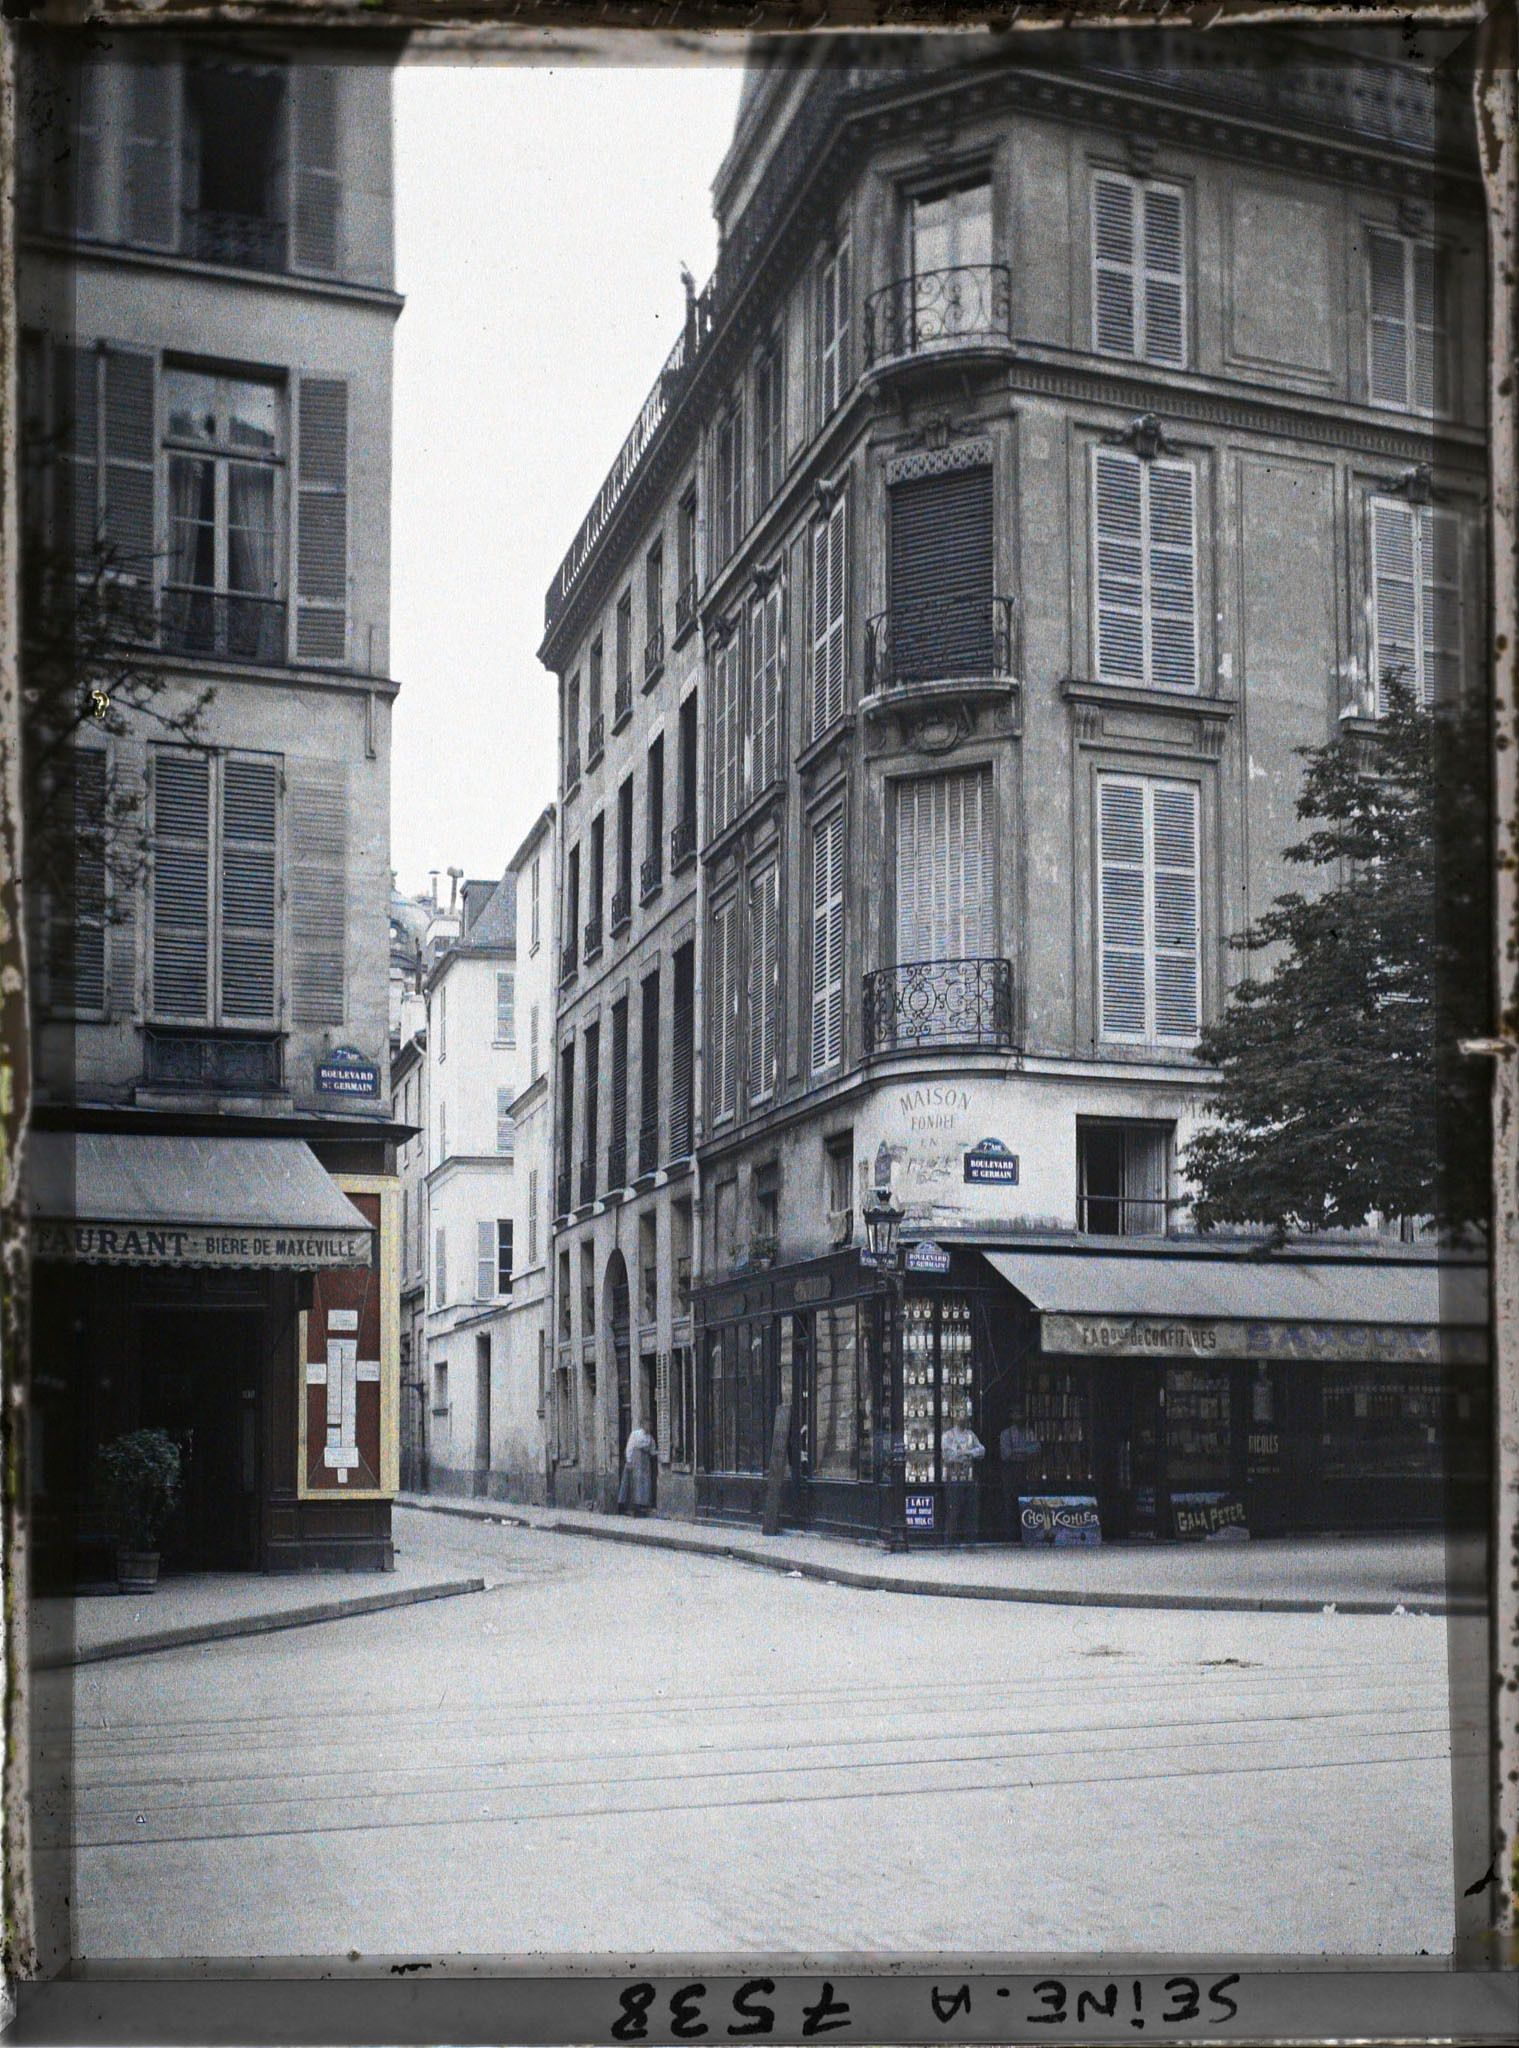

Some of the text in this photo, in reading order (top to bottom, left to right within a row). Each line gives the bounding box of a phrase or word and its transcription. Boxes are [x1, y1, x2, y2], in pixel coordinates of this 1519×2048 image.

[321, 1069, 374, 1081] BOULEVARD
[333, 1082, 373, 1091] GERMAIN
[900, 1087, 972, 1116] MAISON
[970, 1159, 1014, 1169] BOULEVARD
[980, 1170, 1012, 1179] GERMAIN
[253, 1238, 271, 1256] DE
[911, 1498, 930, 1507] LAIT
[1051, 1510, 1100, 1529] KOHLER
[610, 1978, 852, 2041] 7538
